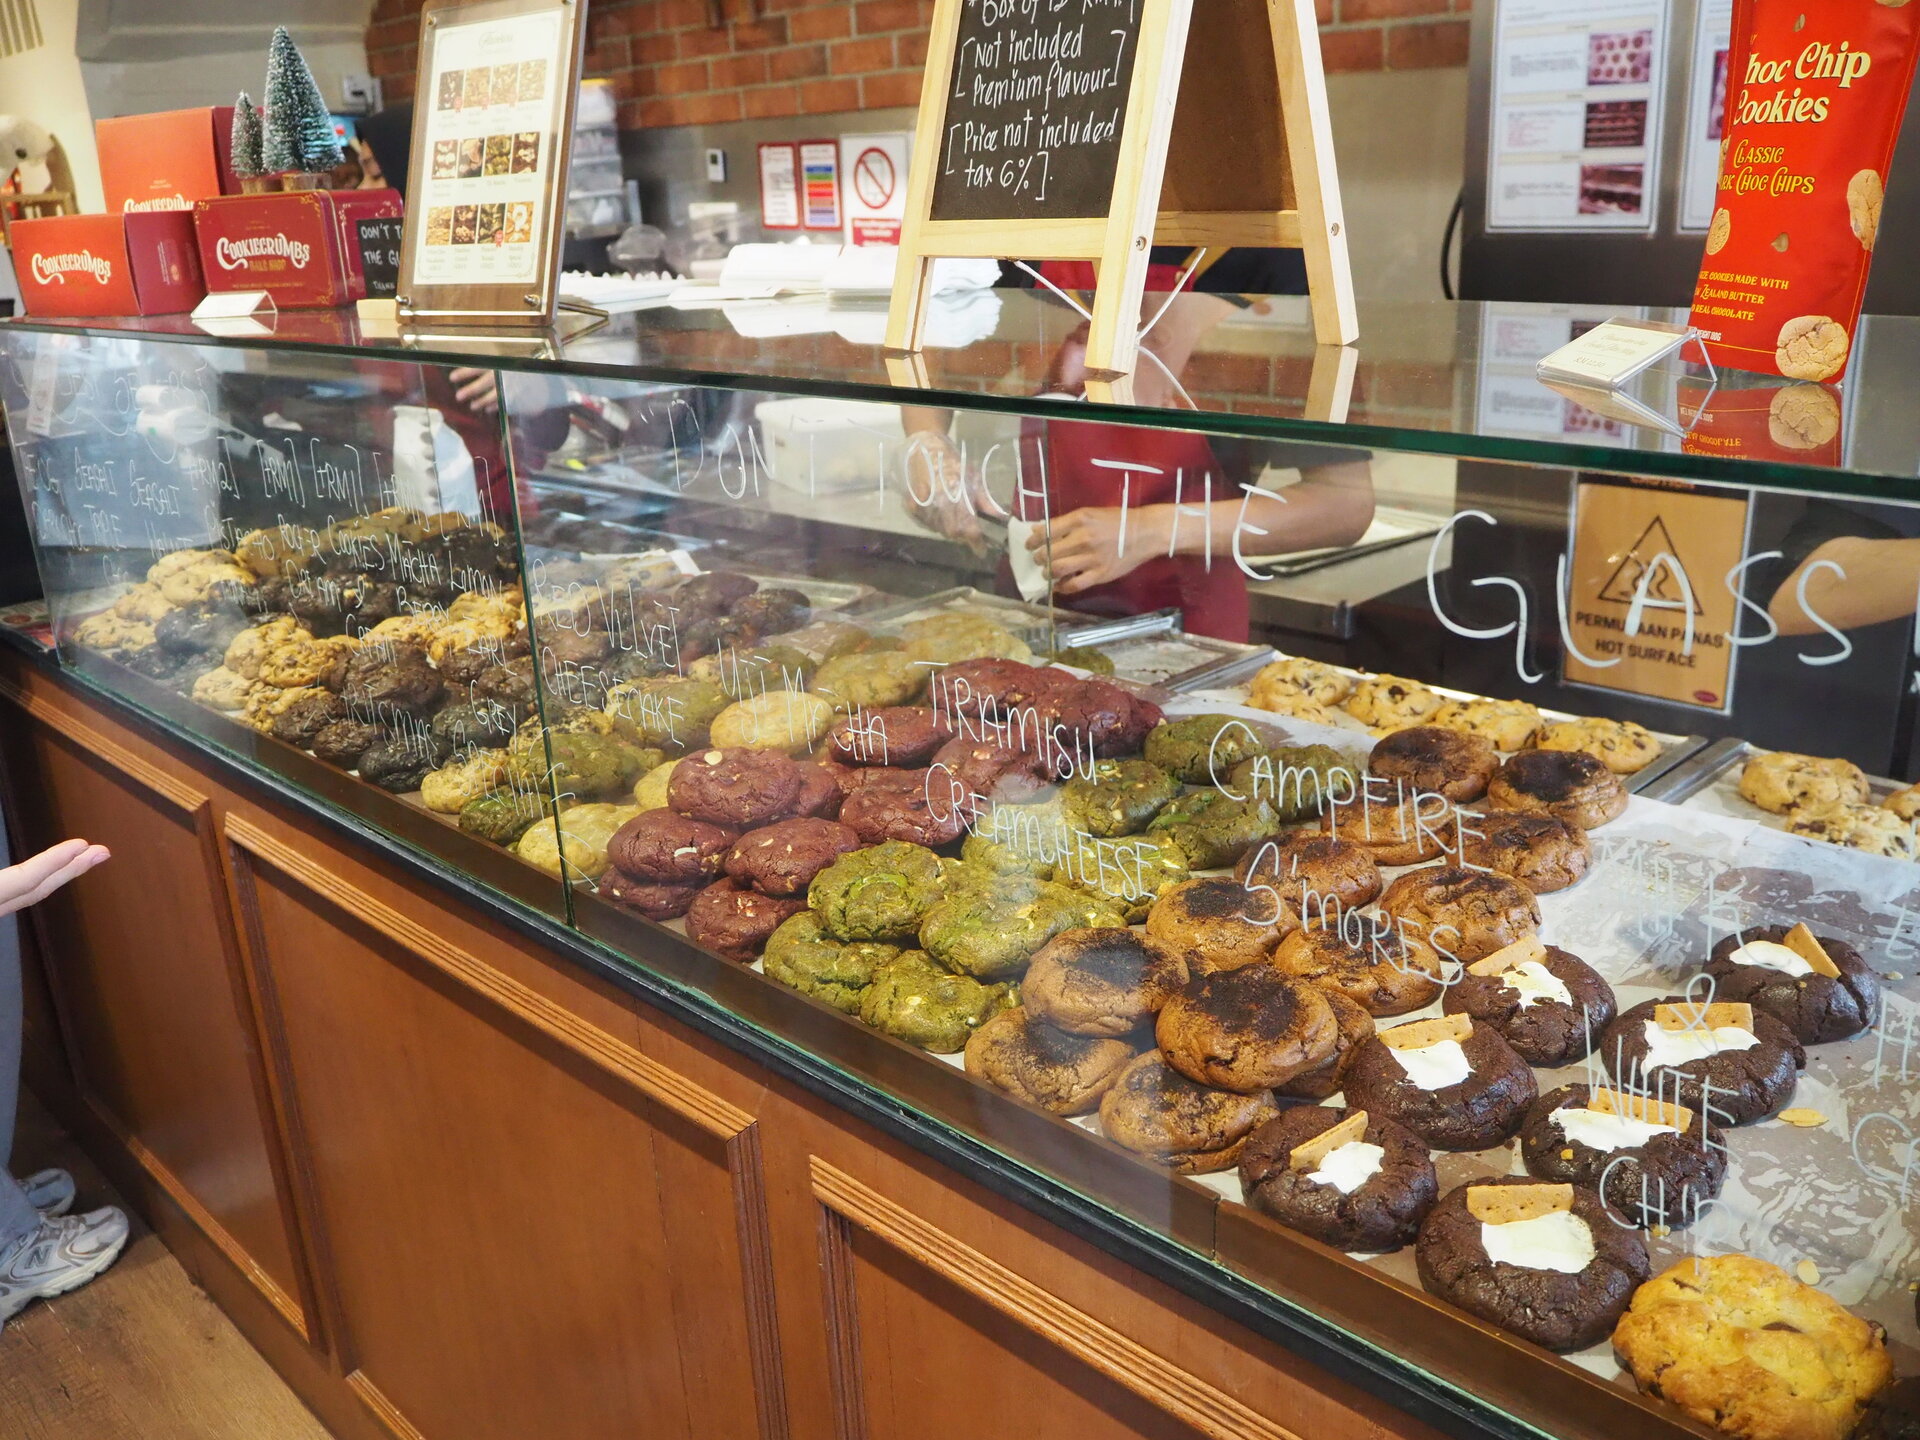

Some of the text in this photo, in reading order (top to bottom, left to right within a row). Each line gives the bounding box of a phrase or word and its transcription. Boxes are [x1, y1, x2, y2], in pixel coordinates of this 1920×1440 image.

[1009, 22, 1083, 65] included
[1795, 41, 1871, 88] Chip
[973, 69, 1042, 109] Premium
[1004, 109, 1033, 147] not
[1039, 108, 1119, 148] included
[964, 158, 994, 187] tax
[31, 249, 111, 285] COOKIECRUMBS
[216, 232, 310, 270] COOKIECRUMBS
[363, 250, 383, 266] THE
[1728, 290, 1765, 305] BUTTER
[1734, 274, 1758, 286] MADE
[1760, 277, 1790, 290] WITH
[1711, 306, 1755, 321] CHOCOLATE
[1090, 458, 1287, 580] THE
[1576, 611, 1668, 641] PERMUAAN
[1595, 638, 1698, 668] HOT SURFACE
[913, 660, 1098, 786] TIRAMISU
[1209, 720, 1494, 874] CAMPFIRE
[1240, 841, 1465, 986] S'MORES
[1583, 1002, 1744, 1164] WHITE
